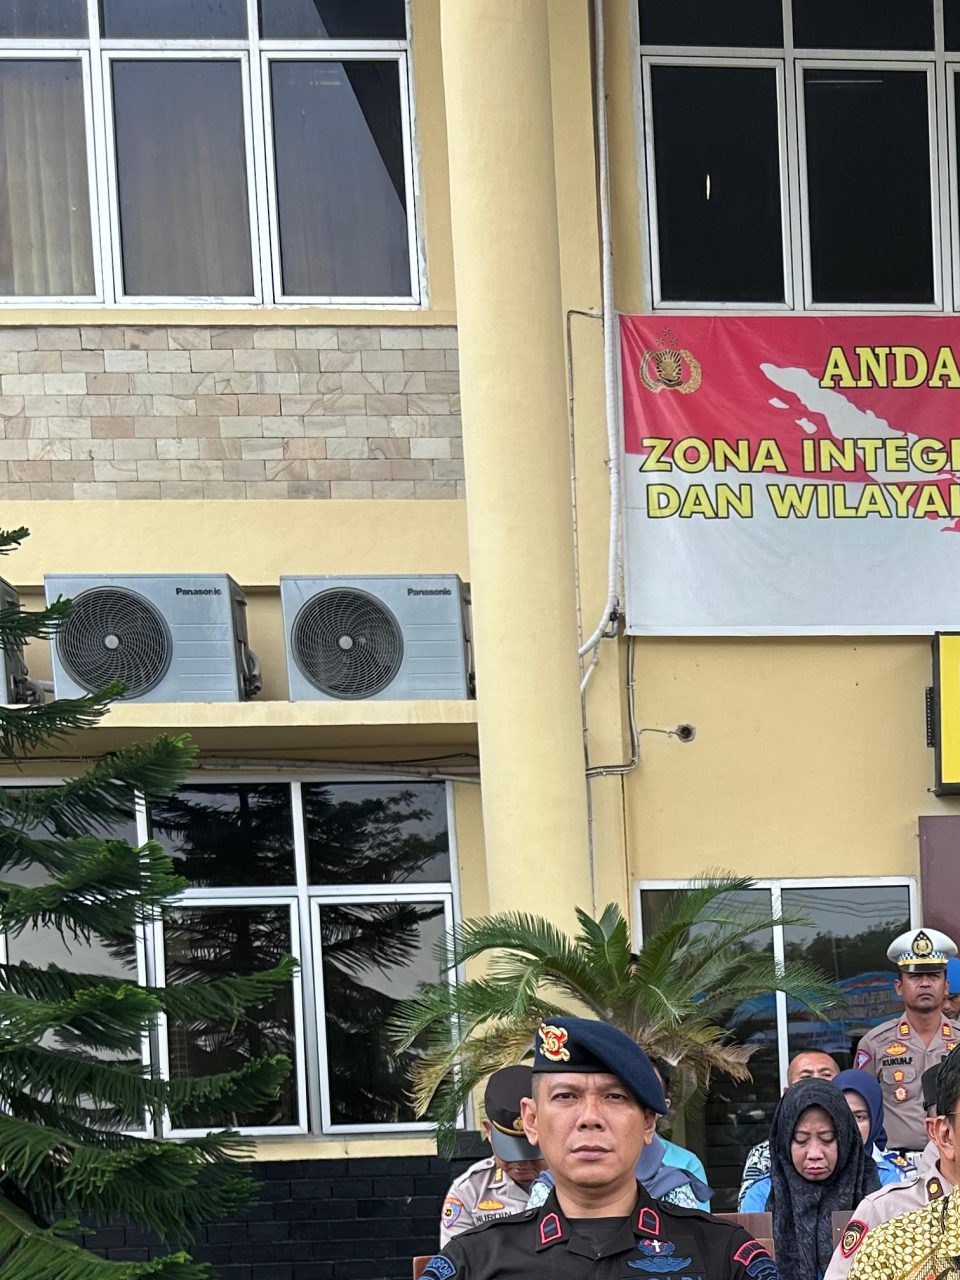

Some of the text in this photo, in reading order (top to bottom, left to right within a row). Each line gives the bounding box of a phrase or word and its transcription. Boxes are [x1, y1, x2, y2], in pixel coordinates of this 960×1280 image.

[639, 437, 788, 473] ZONA
[646, 483, 754, 519] DAN
[176, 587, 222, 596] Panasonic
[407, 587, 452, 596] Panasonic
